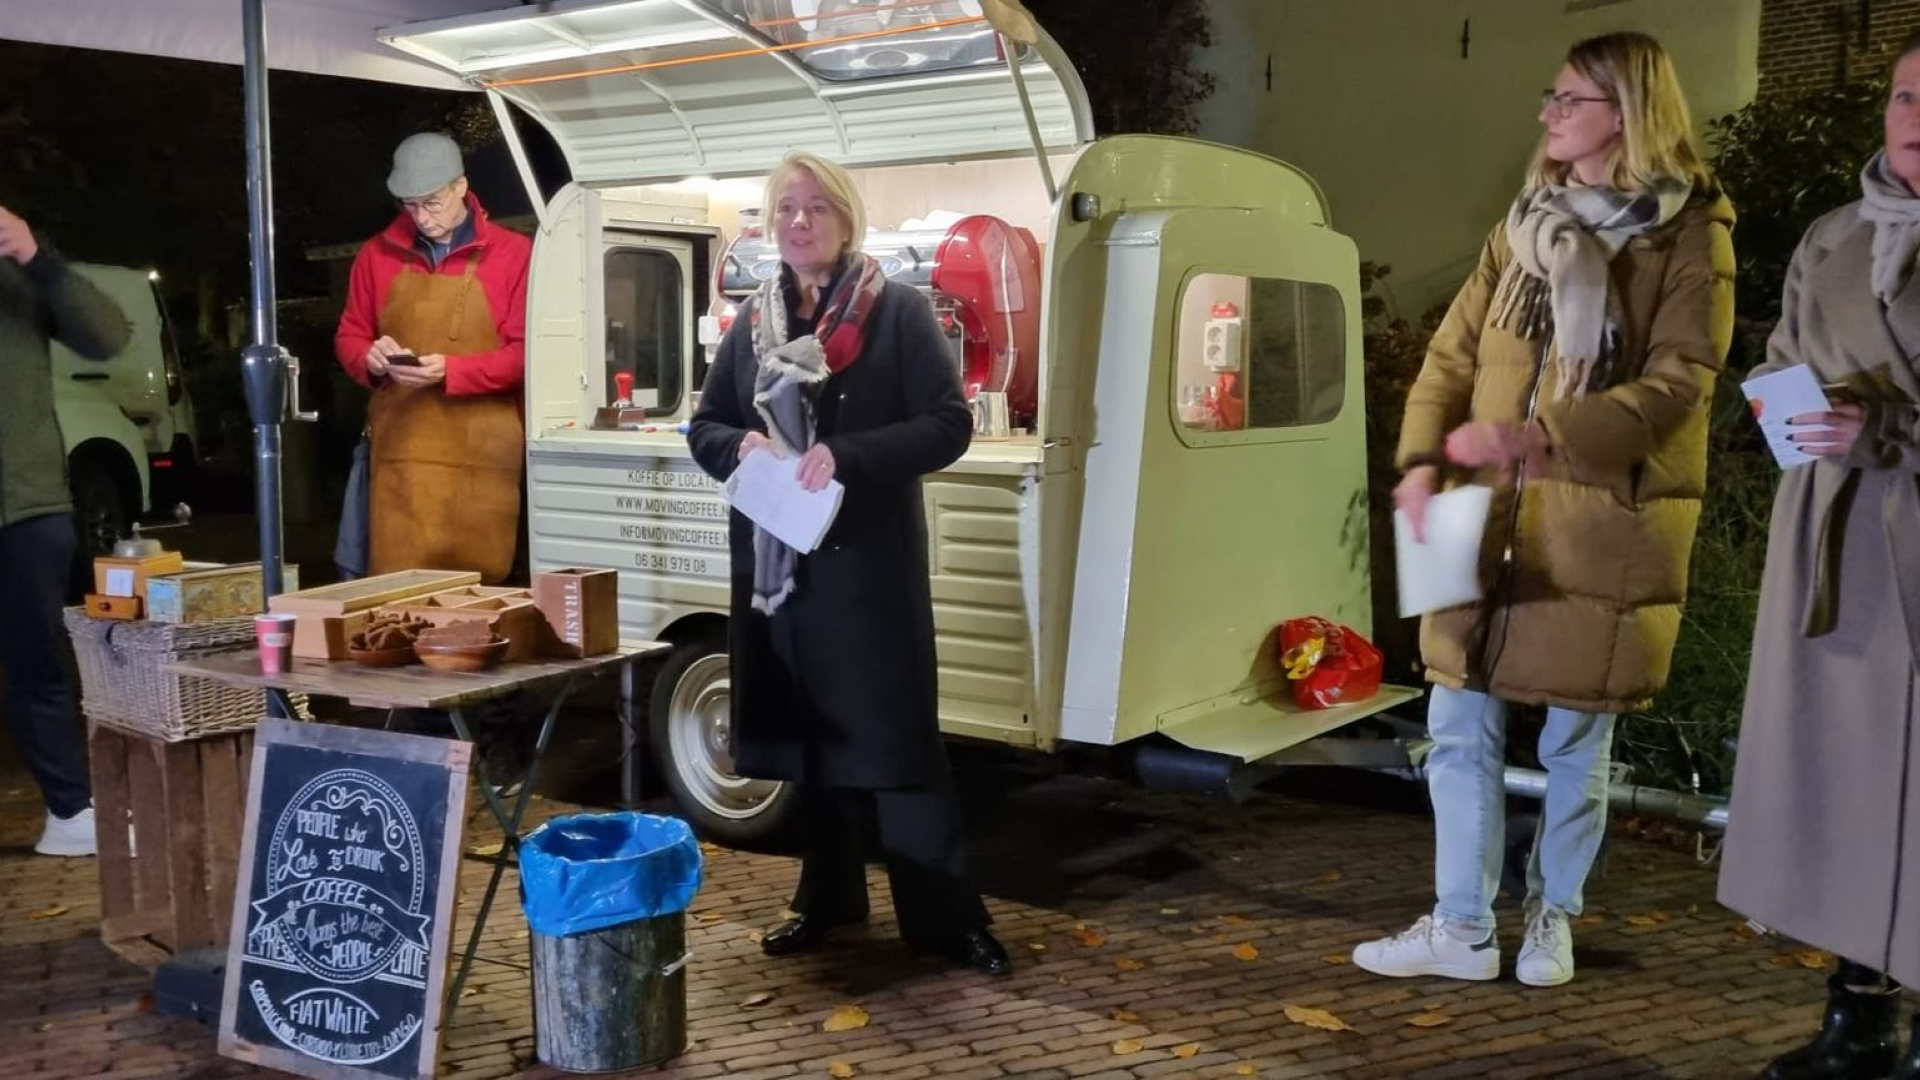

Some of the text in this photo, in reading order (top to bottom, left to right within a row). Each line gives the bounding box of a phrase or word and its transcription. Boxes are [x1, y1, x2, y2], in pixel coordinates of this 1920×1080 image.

[635, 552, 706, 573] 06 341 979 08
[564, 581, 579, 643] TRASH
[296, 809, 341, 839] PEOPLE
[345, 845, 386, 873] DRINK
[303, 880, 367, 906] COFFEE
[332, 939, 374, 968] PEOPLE
[290, 999, 324, 1028] FLAT
